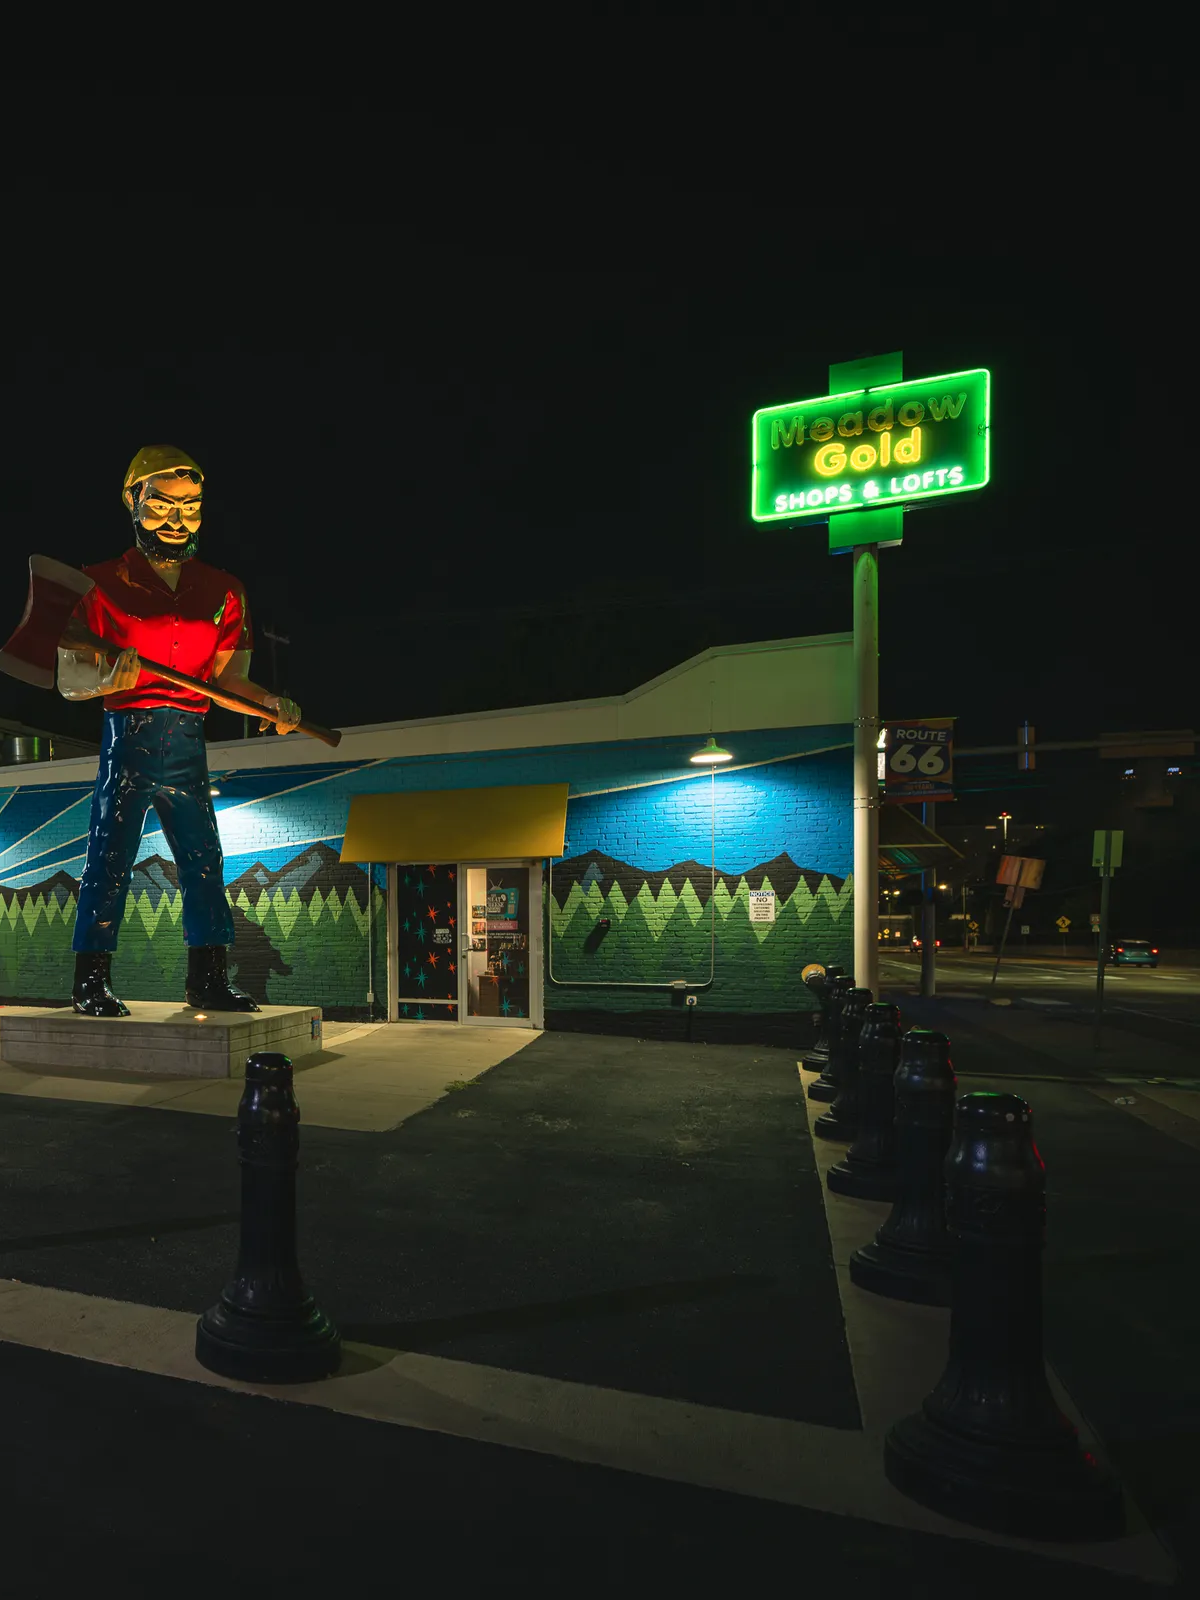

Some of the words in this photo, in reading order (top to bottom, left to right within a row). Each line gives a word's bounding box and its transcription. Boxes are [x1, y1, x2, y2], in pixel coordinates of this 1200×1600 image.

[770, 392, 968, 450] Meadow
[813, 426, 922, 477] Gold
[774, 484, 853, 513] SHOPS
[862, 480, 880, 499] &
[890, 466, 964, 495] LOFTS
[896, 728, 947, 742] ROUTE
[889, 744, 945, 776] 66
